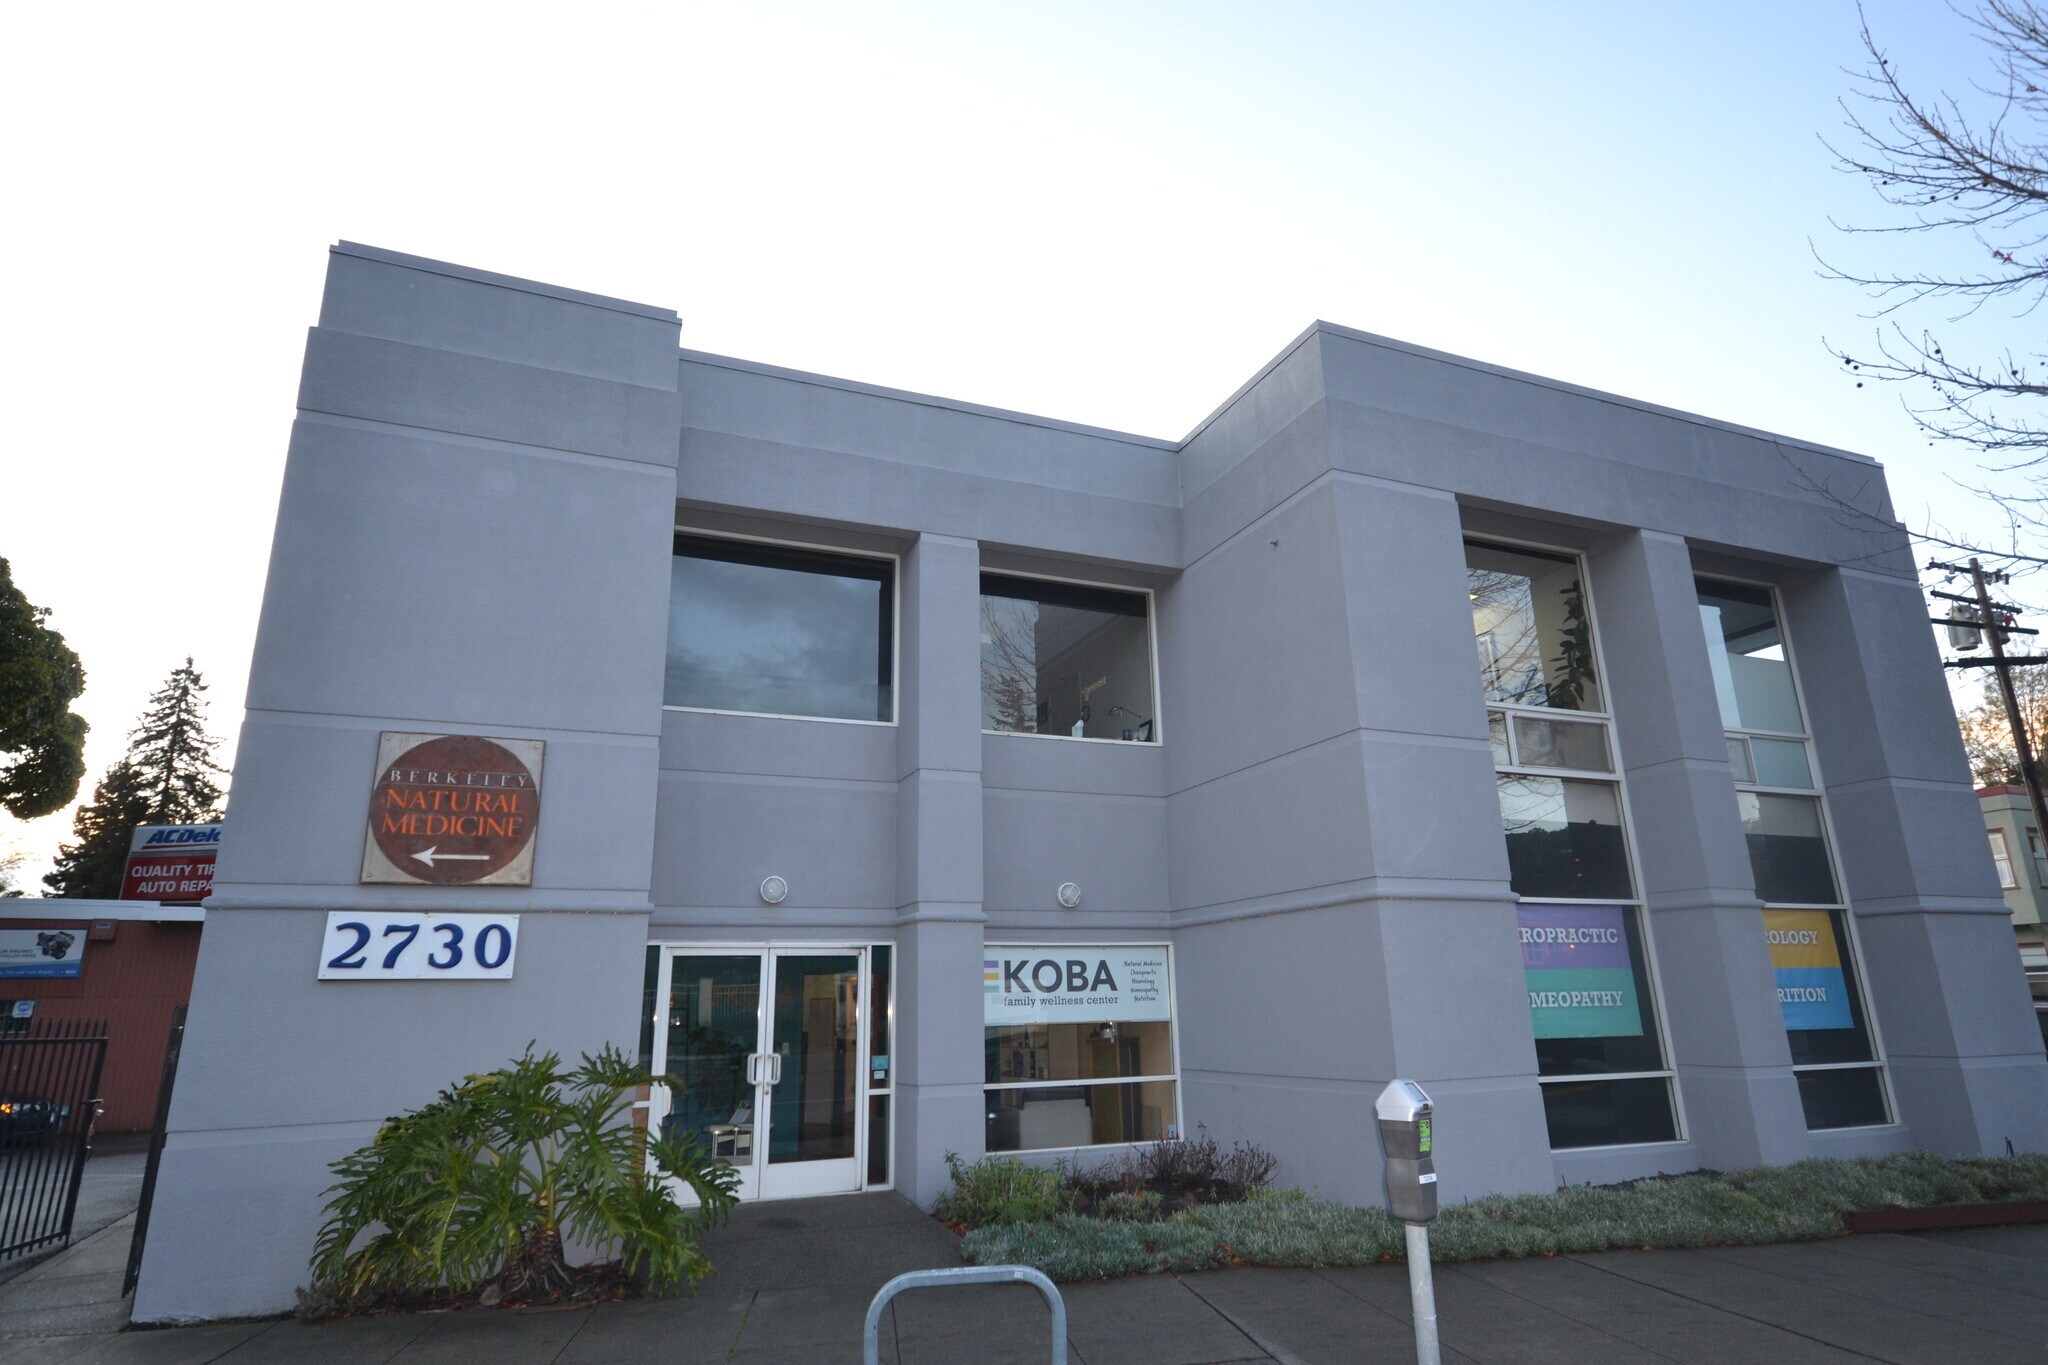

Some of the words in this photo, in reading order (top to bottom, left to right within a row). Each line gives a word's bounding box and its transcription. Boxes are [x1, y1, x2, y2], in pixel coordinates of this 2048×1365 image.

[391, 770, 528, 787] BERKELEY
[386, 789, 524, 813] NATURAL
[382, 813, 523, 837] MEDICINE
[131, 865, 192, 878] QUALITY
[136, 881, 176, 893] AUTO
[327, 921, 512, 970] 2730
[1004, 959, 1118, 993] KOBA
[1003, 996, 1036, 1008] family
[1040, 995, 1084, 1006] wellness
[1086, 995, 1119, 1005] center
[1528, 991, 1622, 1008] MEOPATHY
